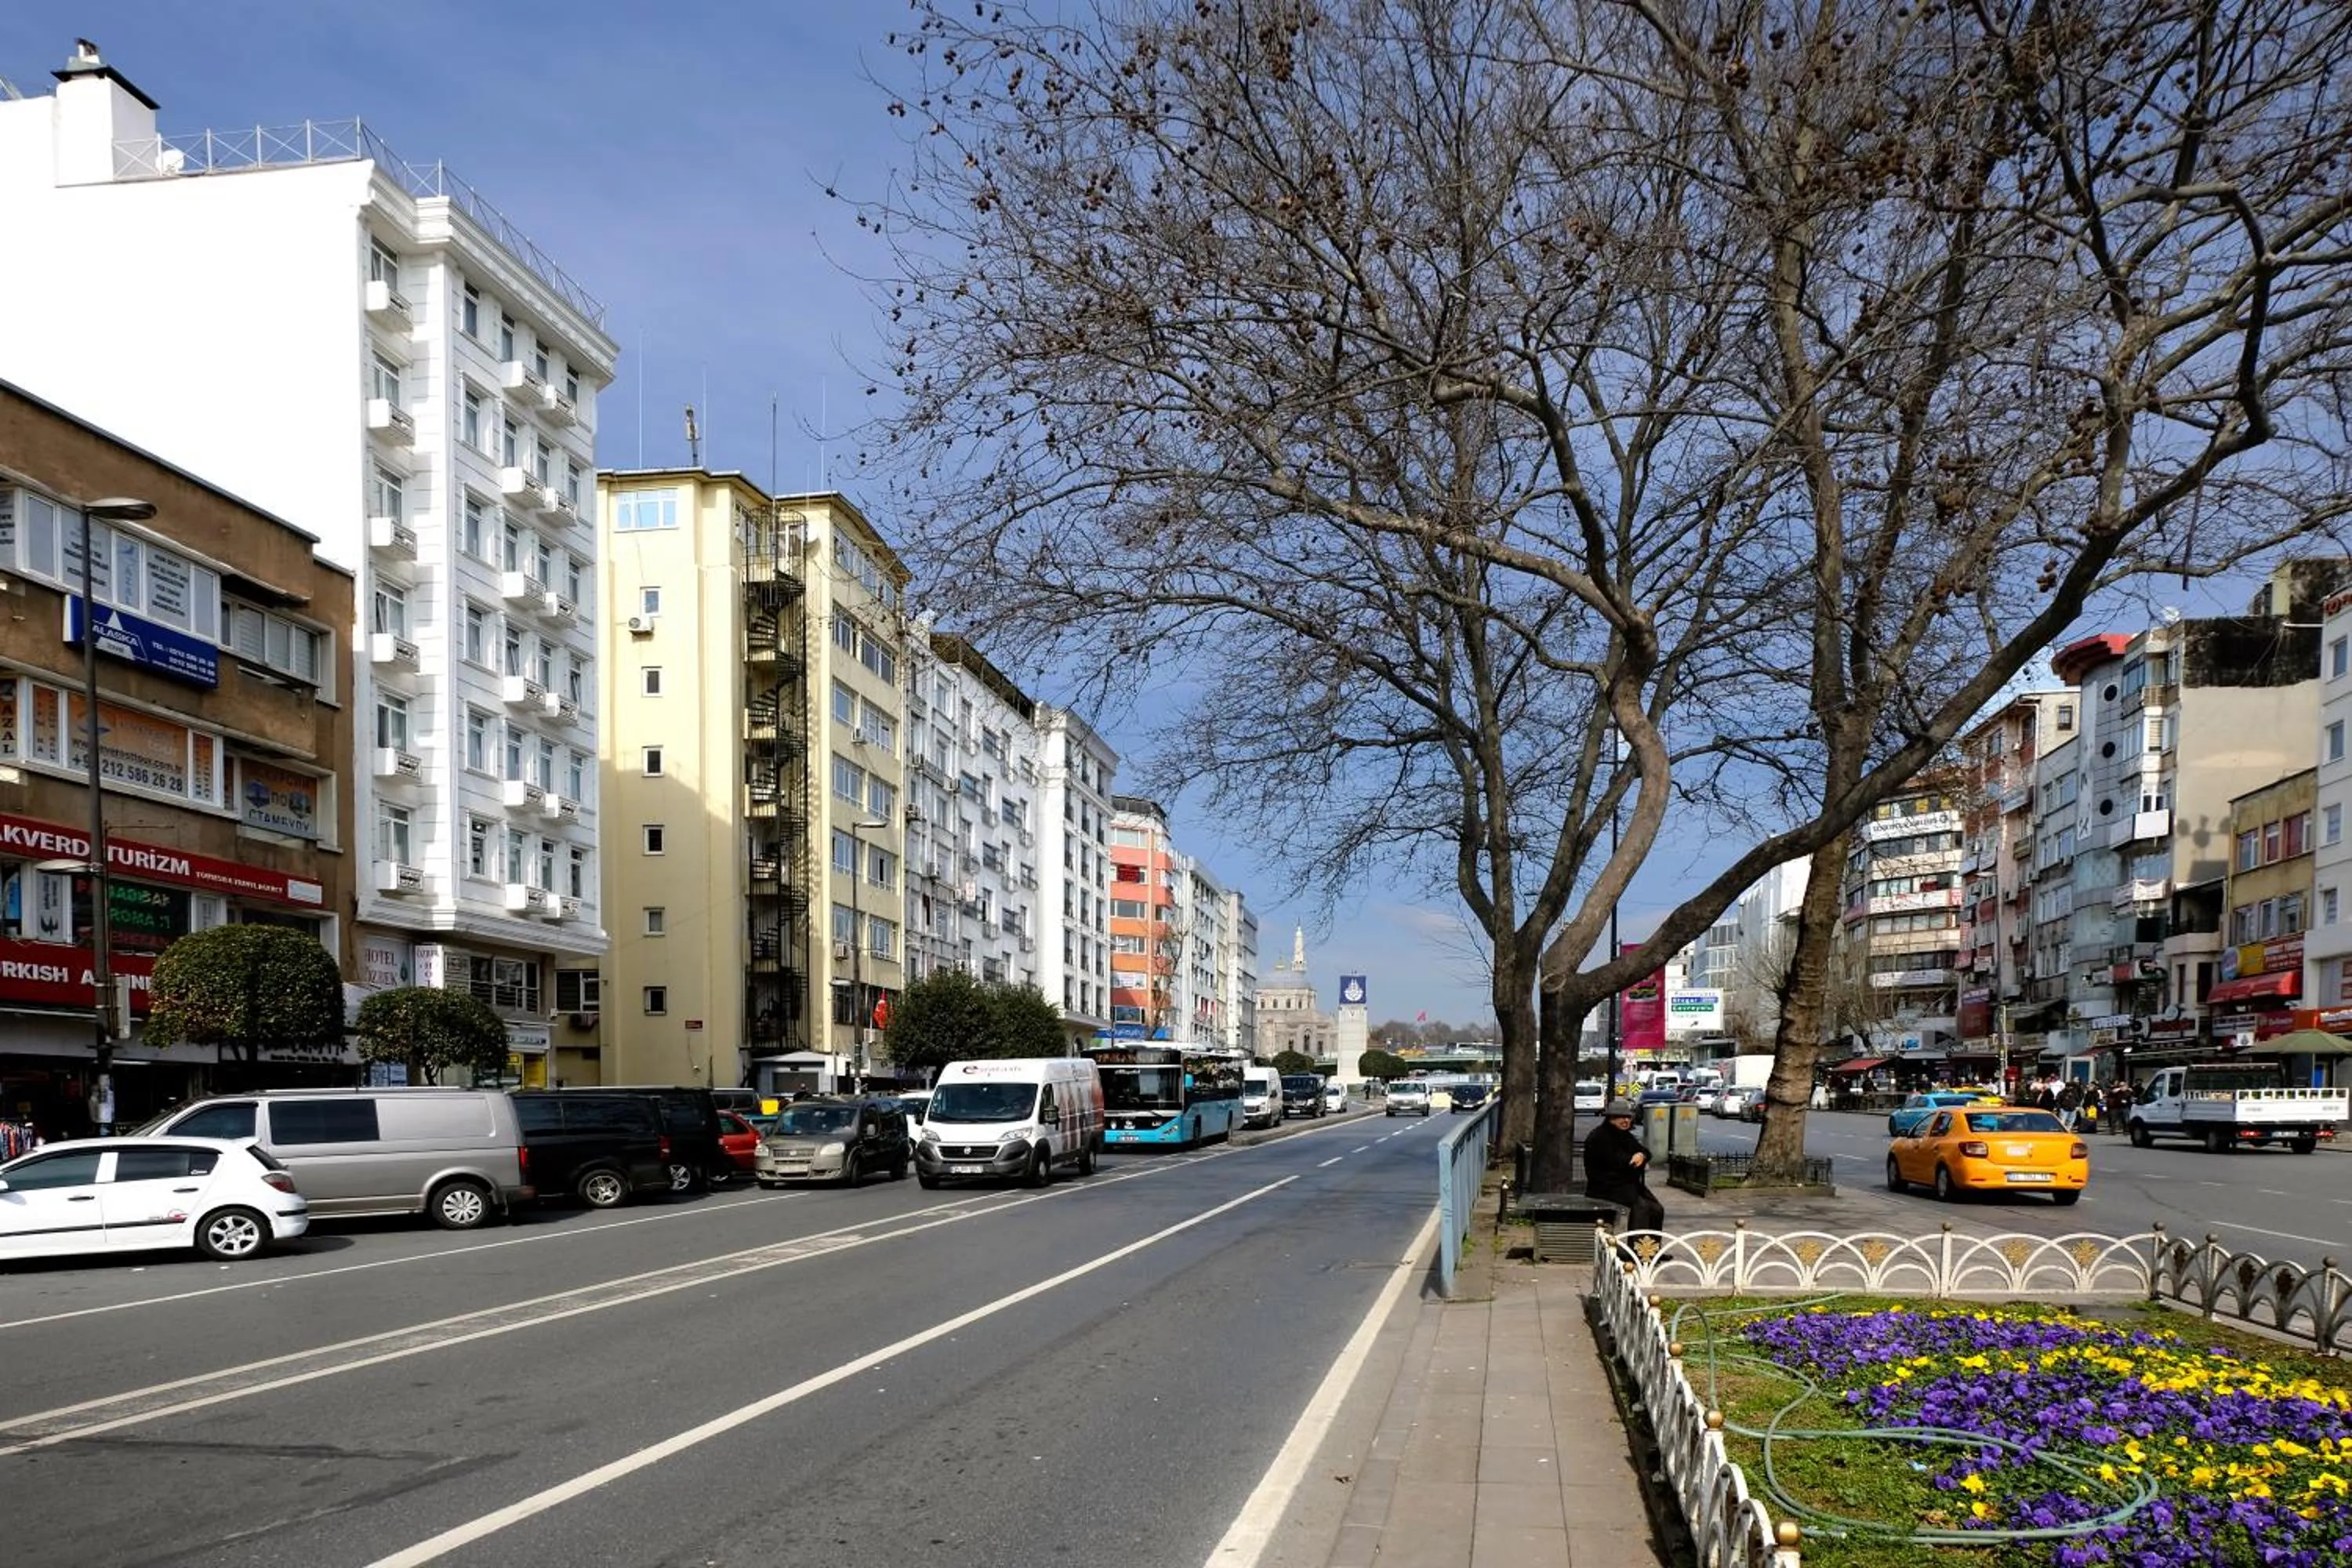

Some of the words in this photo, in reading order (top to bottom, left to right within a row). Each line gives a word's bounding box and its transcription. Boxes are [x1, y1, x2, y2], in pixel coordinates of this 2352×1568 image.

[93, 625, 139, 647] ALASKA
[101, 759, 124, 777] 212
[127, 764, 149, 783] 586
[152, 772, 166, 788] 26
[169, 776, 183, 792] 28
[107, 845, 191, 876] TURİZM
[365, 948, 397, 967] HOTEL
[0, 960, 69, 982] RKISH
